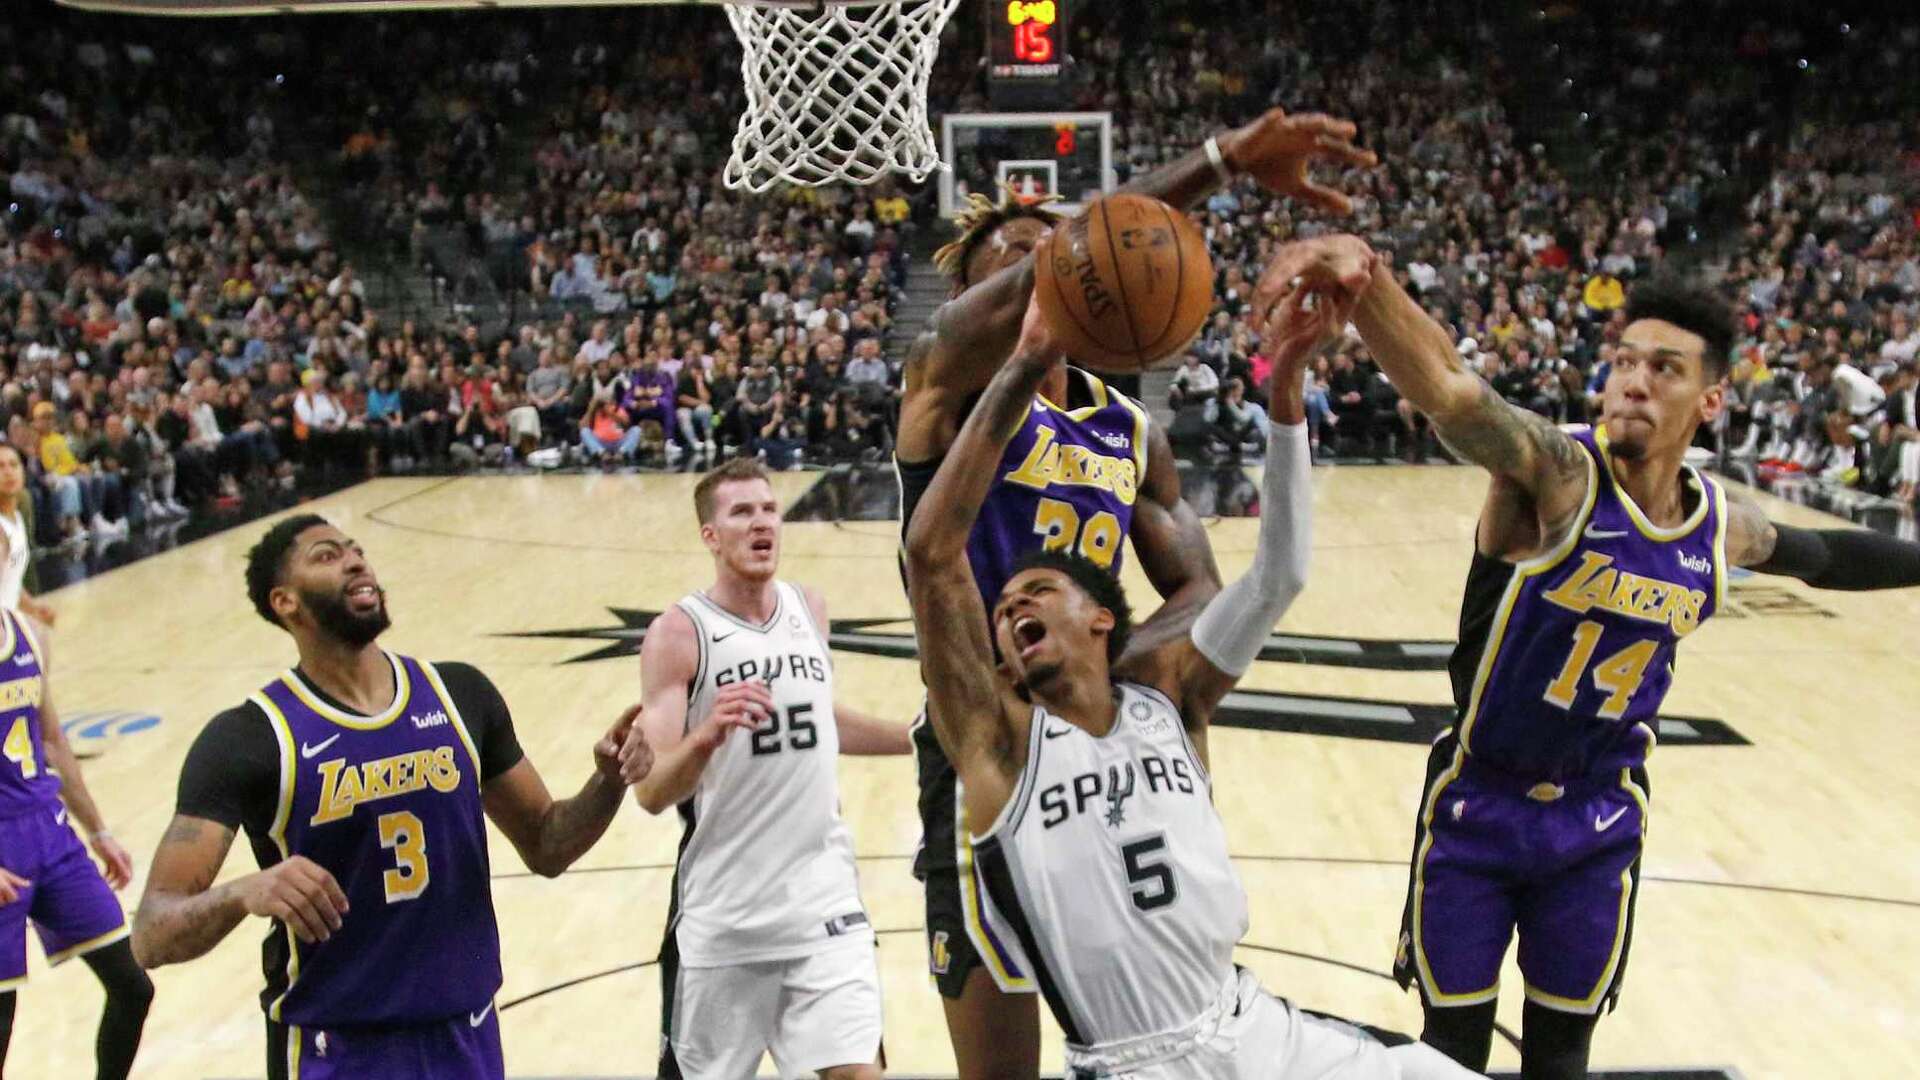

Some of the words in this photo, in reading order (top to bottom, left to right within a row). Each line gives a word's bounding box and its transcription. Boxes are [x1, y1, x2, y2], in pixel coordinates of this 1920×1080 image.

[1014, 22, 1054, 62] 15
[1004, 424, 1137, 505] LAKERS
[1541, 550, 1707, 637] LAKERS
[1677, 549, 1712, 575] wish
[1543, 620, 1659, 720] 14
[411, 710, 448, 729] wish
[752, 703, 818, 756] 25
[310, 746, 460, 827] LAKERS
[1040, 757, 1195, 830] SPURS
[378, 811, 430, 904] 3
[1120, 831, 1180, 913] 5
